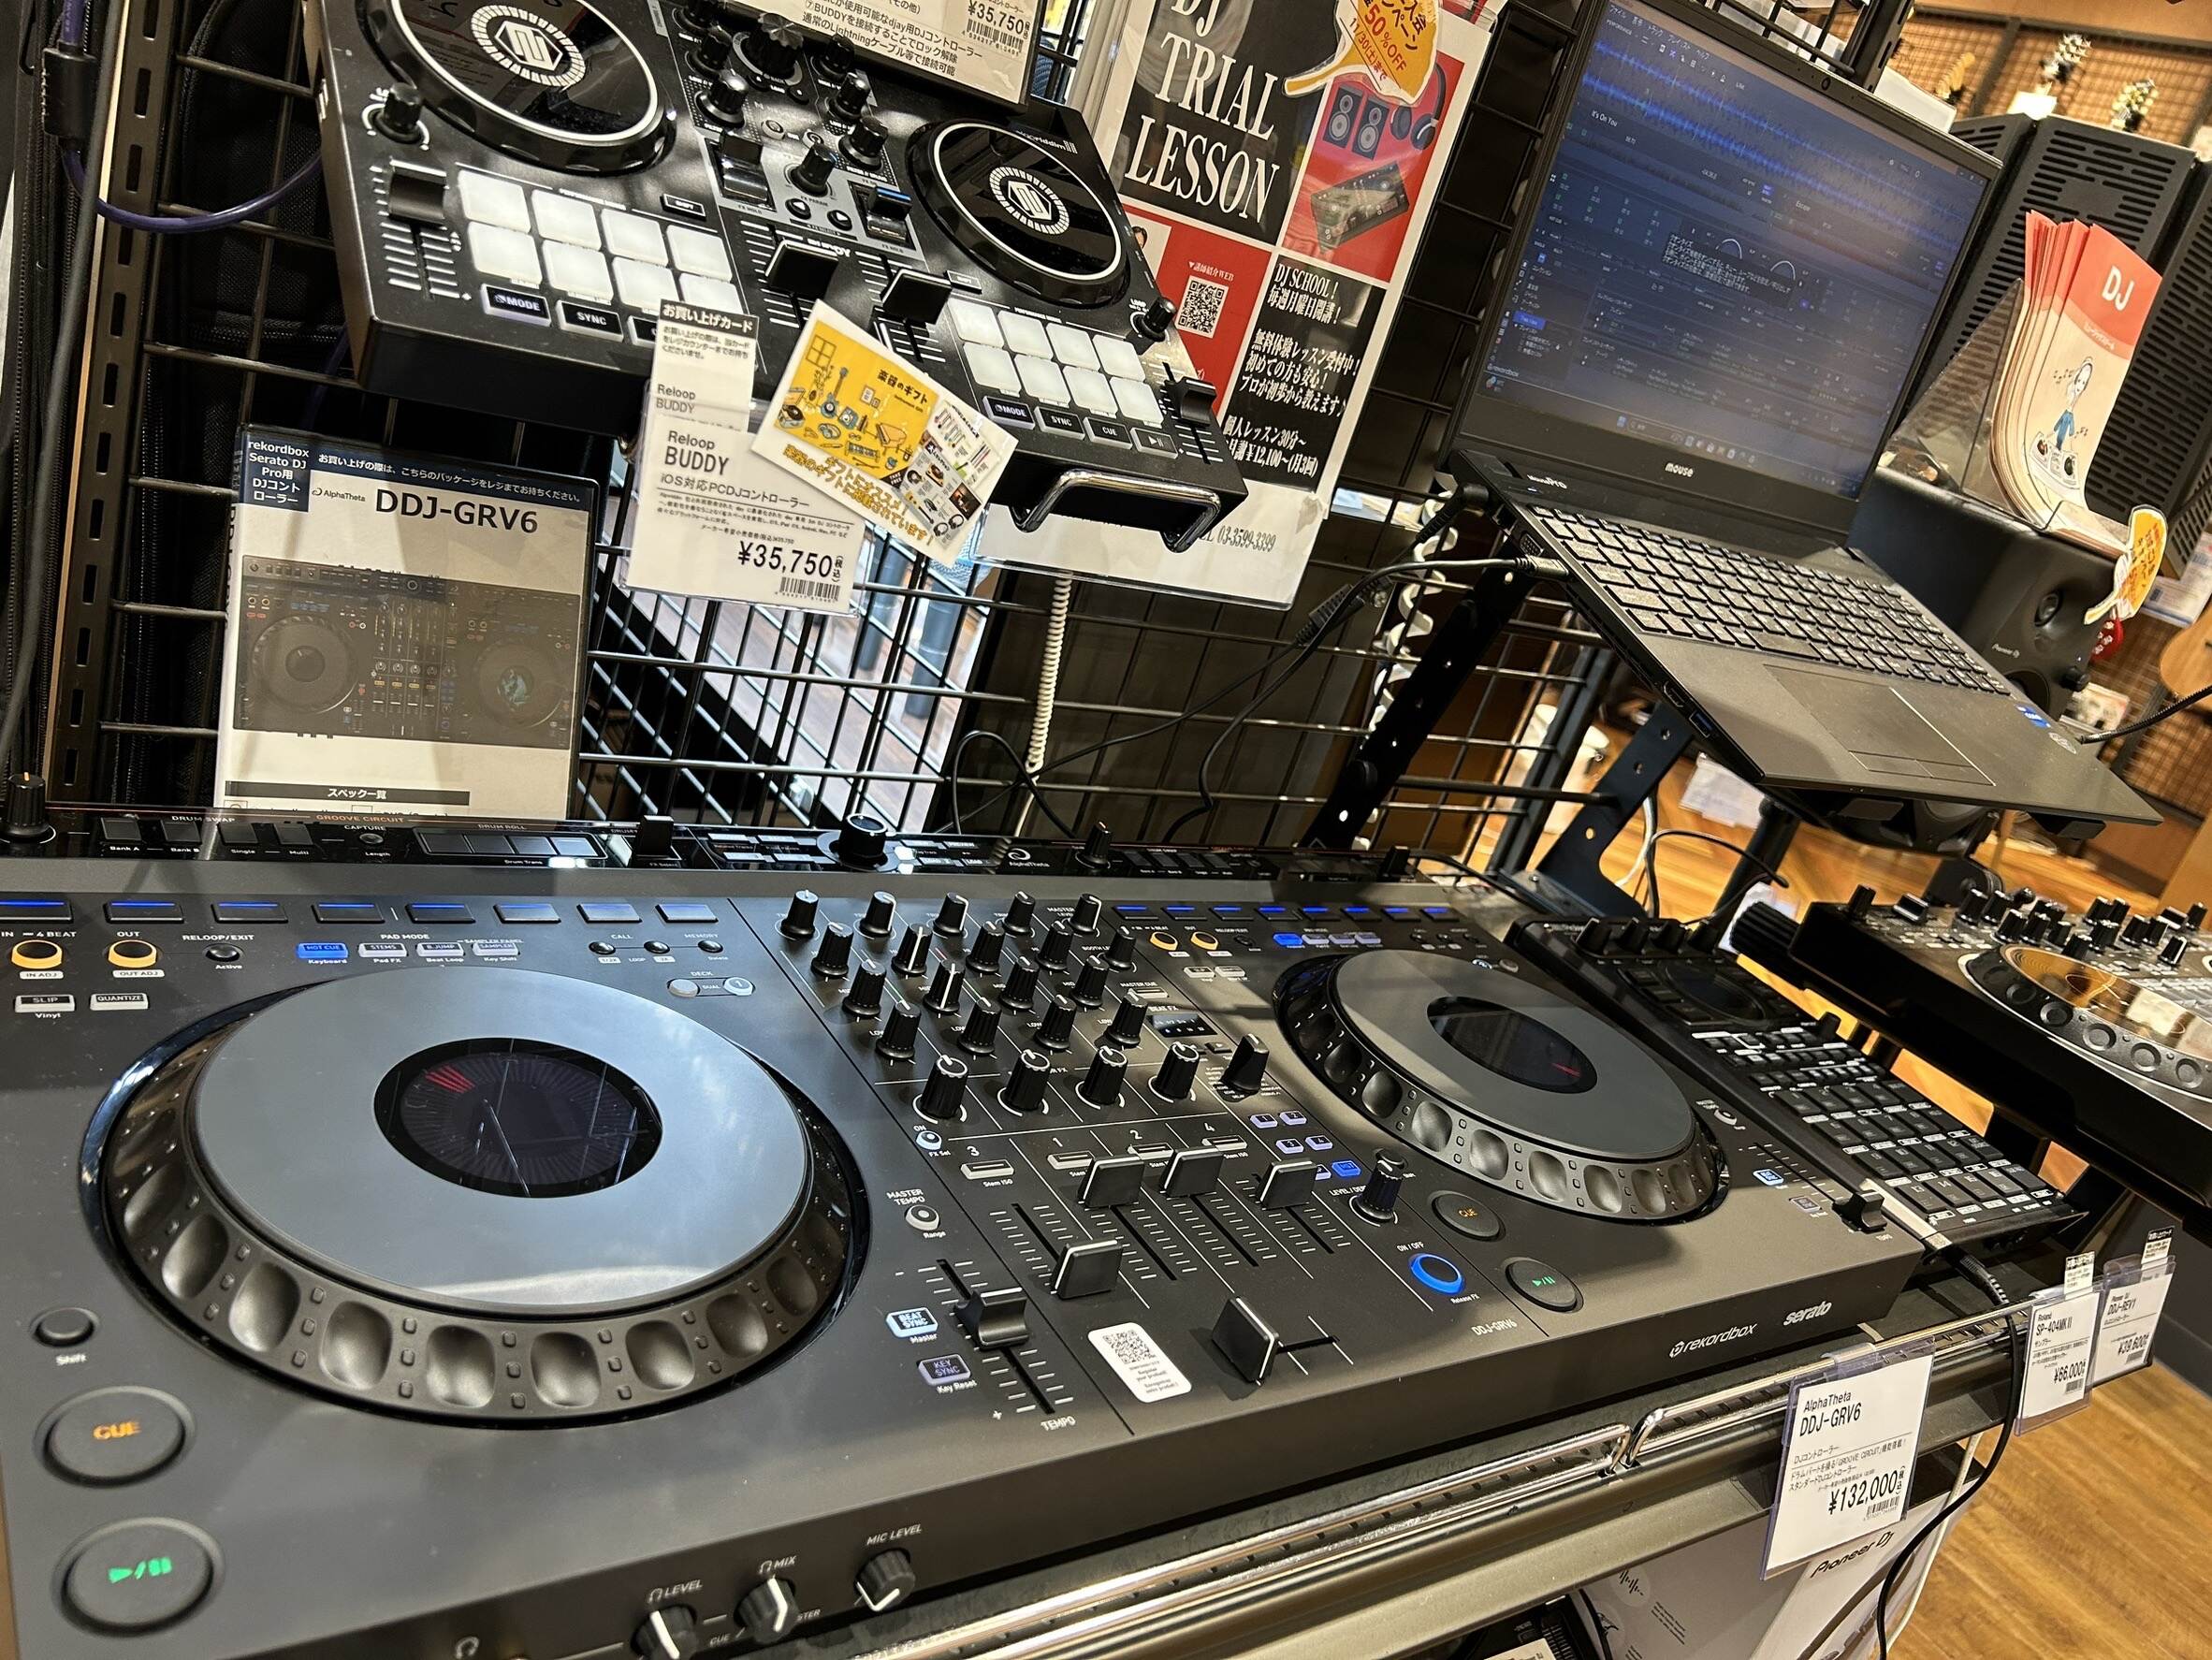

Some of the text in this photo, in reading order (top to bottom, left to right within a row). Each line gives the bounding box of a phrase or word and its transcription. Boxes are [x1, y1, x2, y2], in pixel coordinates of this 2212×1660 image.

[968, 0, 1024, 35] ¥35,750
[1155, 32, 1279, 140] TRIAL
[1125, 115, 1280, 223] LESSON
[1273, 263, 1288, 290] DJ
[2102, 265, 2134, 312] DJ
[506, 298, 540, 313] MODE
[576, 312, 607, 326] SYNC
[662, 304, 753, 333] お買い上げカード
[657, 384, 696, 400] Reloop
[877, 368, 929, 404] 楽器のギフト
[656, 398, 696, 415] BUDDY
[1002, 405, 1027, 417] MODE
[1052, 415, 1072, 427] SYNC
[1102, 426, 1118, 436] CUE
[668, 430, 715, 451] Reloop
[247, 440, 310, 459] rekordbox
[249, 451, 307, 470] Serato DJ
[664, 445, 730, 475] BUDDY
[261, 466, 293, 481] Pro用
[318, 454, 581, 502] お買い上げの際は、こちらのパッケージをレジまでお持ちください。
[1665, 462, 1695, 479] mouse
[252, 478, 301, 493] DJコント
[661, 473, 809, 508] iOS対応PCDJコントローラー
[254, 491, 298, 504] ローラー
[324, 489, 366, 502] AlphaTheta
[375, 488, 539, 534] DDJ-GRV6
[1216, 525, 1276, 553] 03-3599-3399
[737, 540, 833, 578] ¥35,750
[327, 787, 387, 801] スペック一覧
[316, 814, 405, 823] GROOVE CIRCUIT
[35, 1012, 62, 1020] Vinyl
[1129, 1129, 1142, 1140] 2
[1204, 1123, 1215, 1131] 4
[1052, 1137, 1063, 1147] 1
[967, 1145, 980, 1158] 3
[886, 1188, 924, 1200] MASTER
[894, 1196, 925, 1206] TEMPO
[923, 1230, 947, 1239] Range
[897, 1311, 924, 1323] BEAT
[1783, 1301, 1832, 1325] serato
[903, 1318, 929, 1329] SYNC
[1472, 1319, 1518, 1336] DDJ-GRV6
[910, 1332, 938, 1344] Master
[1683, 1322, 1757, 1353] rekordbox
[55, 1353, 87, 1366] Shift
[933, 1358, 953, 1369] KEY
[934, 1365, 961, 1377] SYNC
[937, 1378, 978, 1394] Key Reset
[1803, 1390, 1852, 1413] AlphaTheta
[1041, 1416, 1076, 1432] TEMPO
[1799, 1403, 1862, 1437] DDJ-GRV6
[94, 1419, 141, 1441] CUE
[1828, 1470, 1899, 1515] ¥132,000
[866, 1523, 923, 1546] MIC LEVEL
[773, 1555, 796, 1569] MIX
[1811, 1539, 1873, 1579] Pioneer
[664, 1579, 704, 1597] LEVEL
[708, 1633, 731, 1646] CUE
